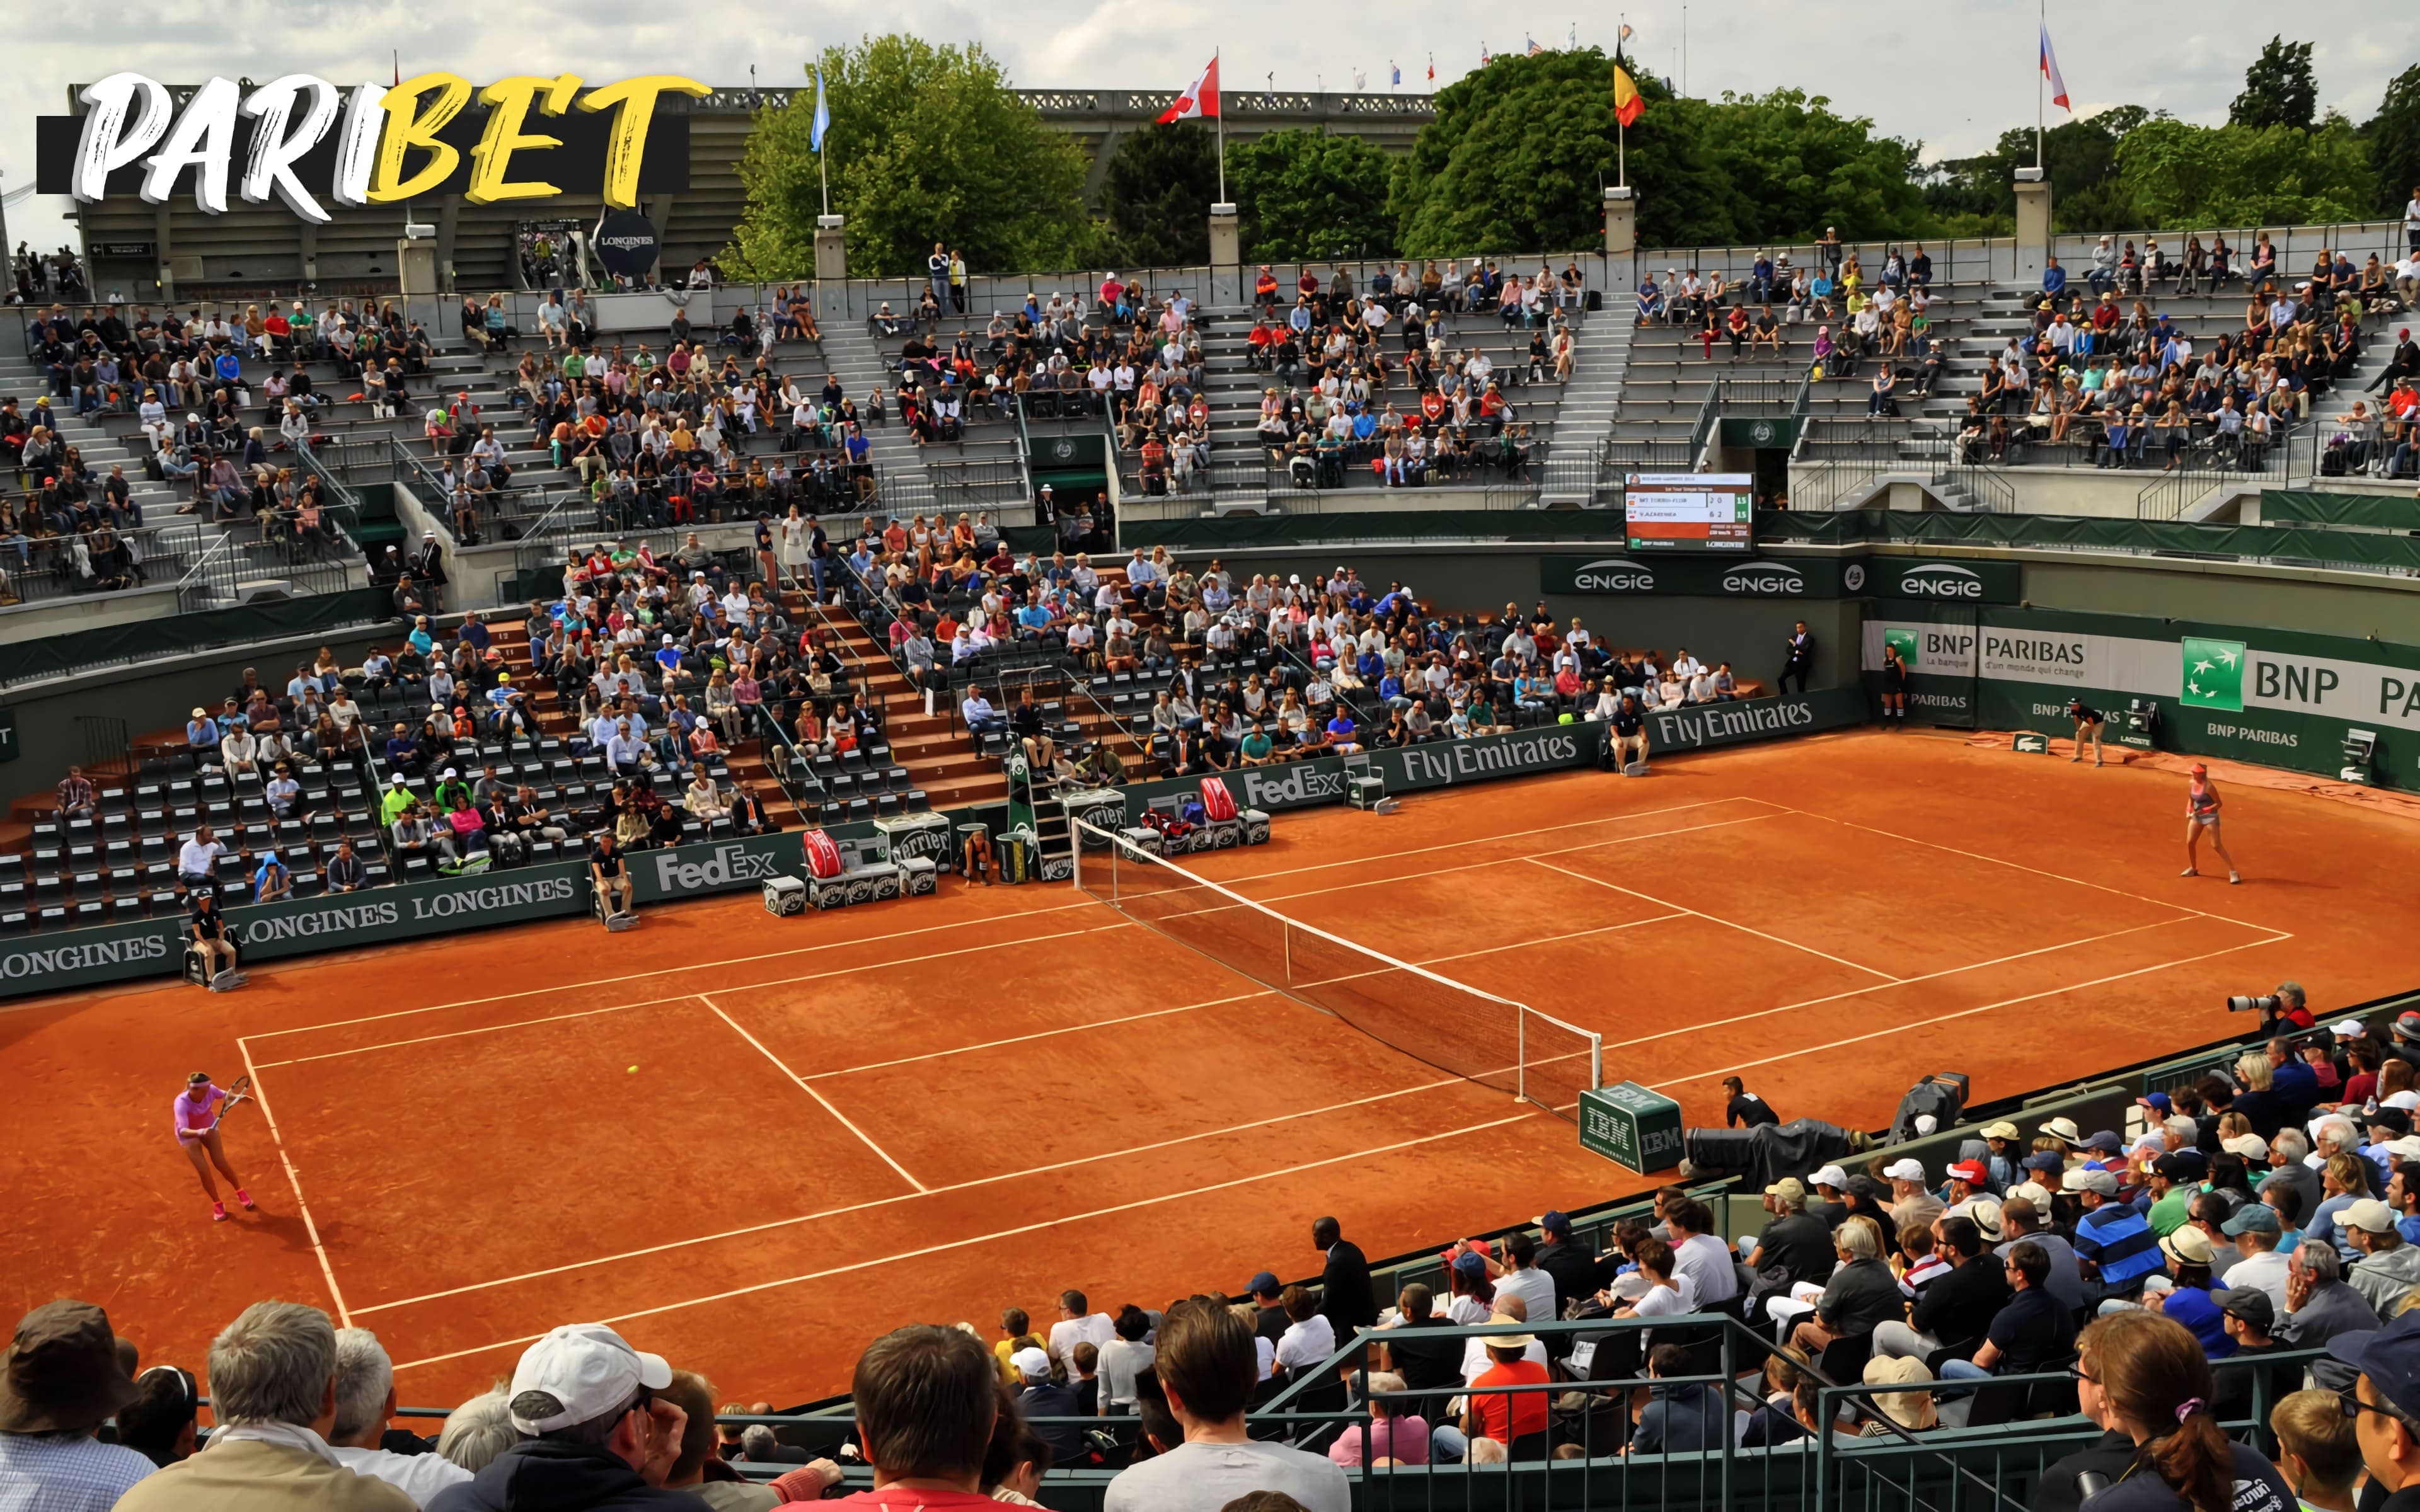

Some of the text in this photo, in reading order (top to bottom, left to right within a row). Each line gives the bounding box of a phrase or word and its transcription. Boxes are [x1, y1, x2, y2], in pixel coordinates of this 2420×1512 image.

[601, 236, 654, 251] LONGINES
[1927, 633, 2084, 665] BNP PARIBAS
[1911, 693, 1966, 708] PARIBAS
[2256, 661, 2339, 704] BNP
[1659, 701, 1812, 746] Fly Emirates
[2032, 703, 2060, 717] BNP
[2121, 735, 2150, 747] LACOSTE
[2207, 722, 2298, 747] BNP PARIBAS
[1401, 735, 1577, 783] Fly Emirates
[1243, 765, 1344, 806] FedEx
[655, 844, 779, 891] FedEx
[413, 876, 575, 920] LONGINES
[0, 934, 167, 979] ONGINES
[1587, 1106, 1629, 1150] IBM
[1641, 1126, 1682, 1155] IBM
